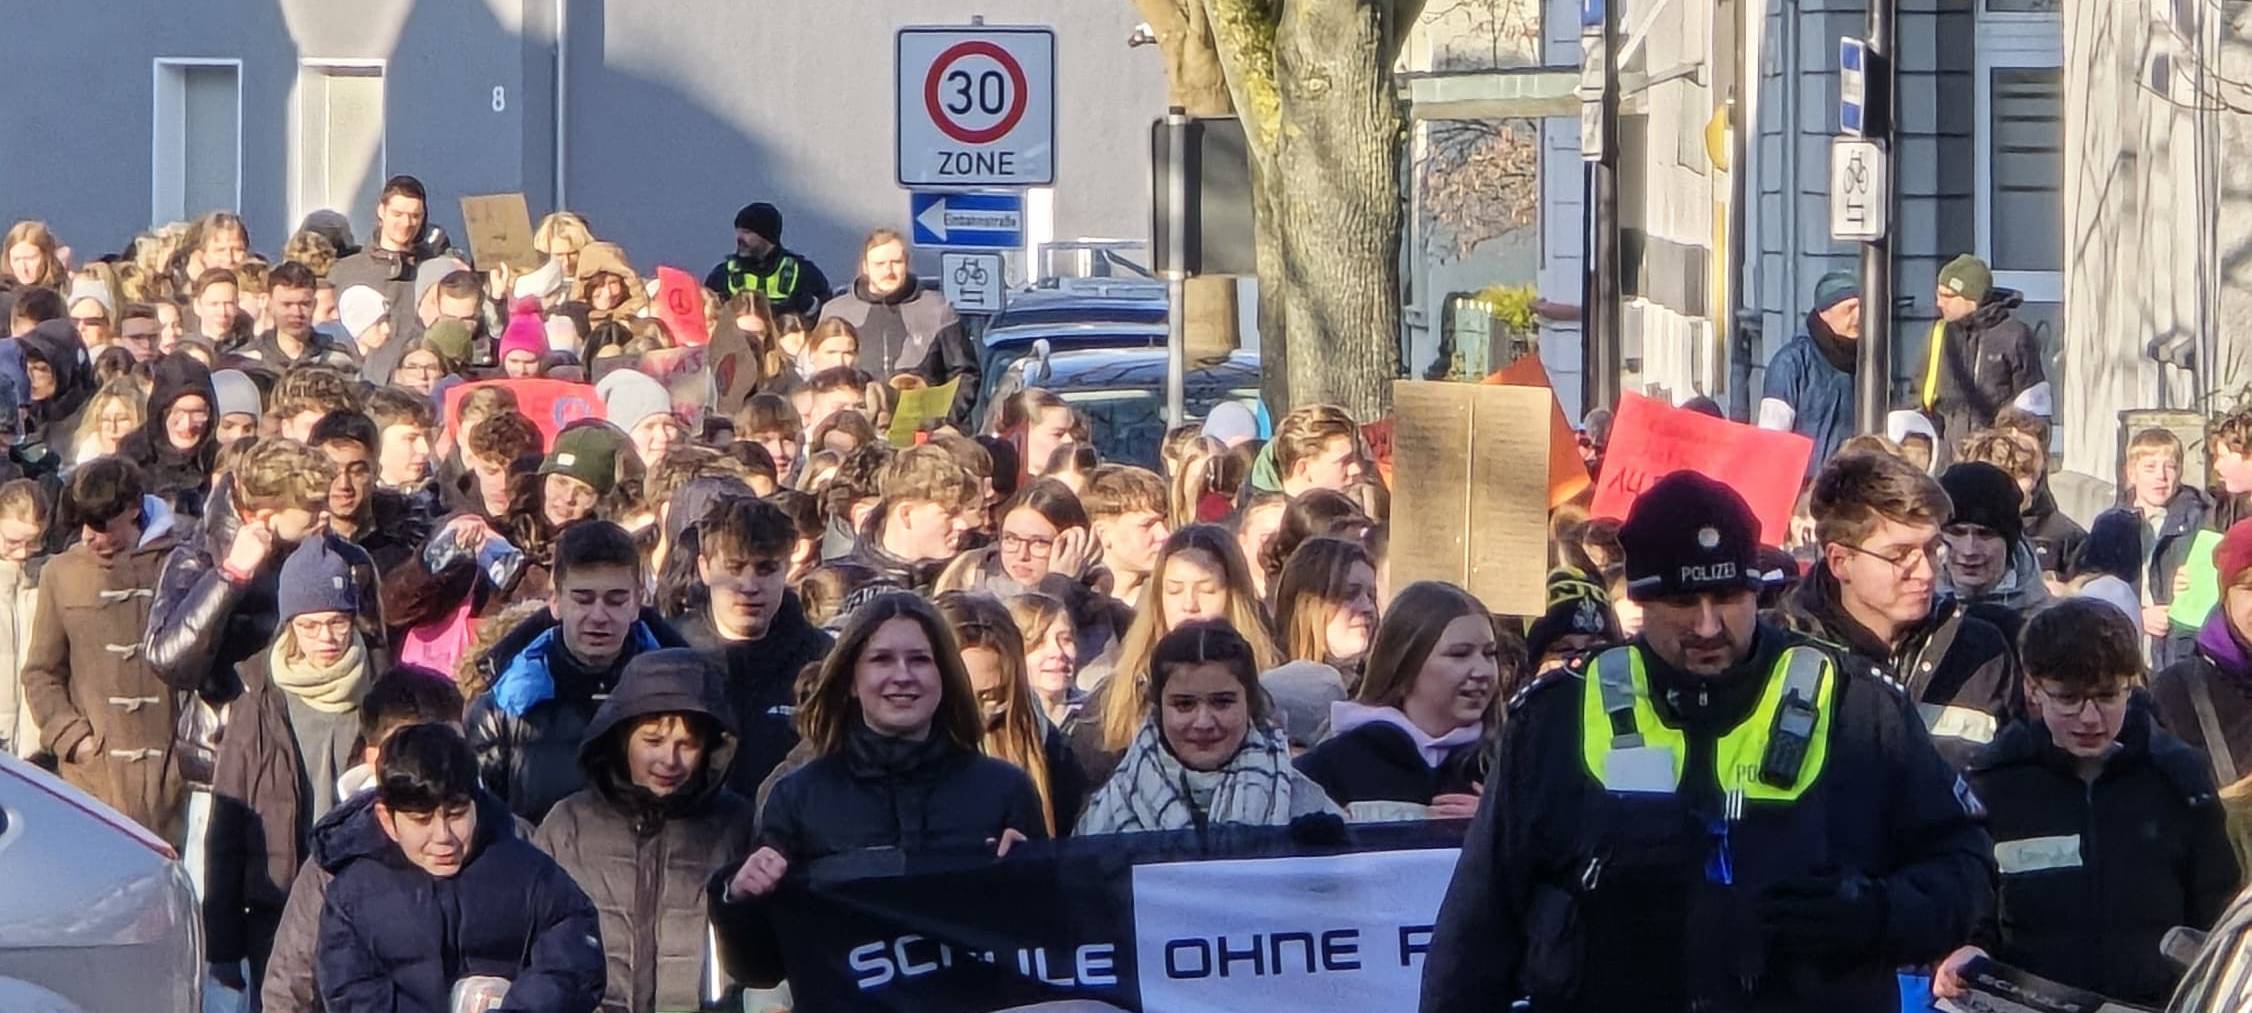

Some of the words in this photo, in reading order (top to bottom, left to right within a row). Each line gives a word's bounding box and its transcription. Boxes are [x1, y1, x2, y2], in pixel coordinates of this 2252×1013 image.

[492, 85, 505, 112] 8
[947, 70, 1005, 115] 30
[938, 151, 1016, 175] ZONE
[849, 934, 1118, 989] SCLE
[1164, 928, 1362, 979] OHNE
